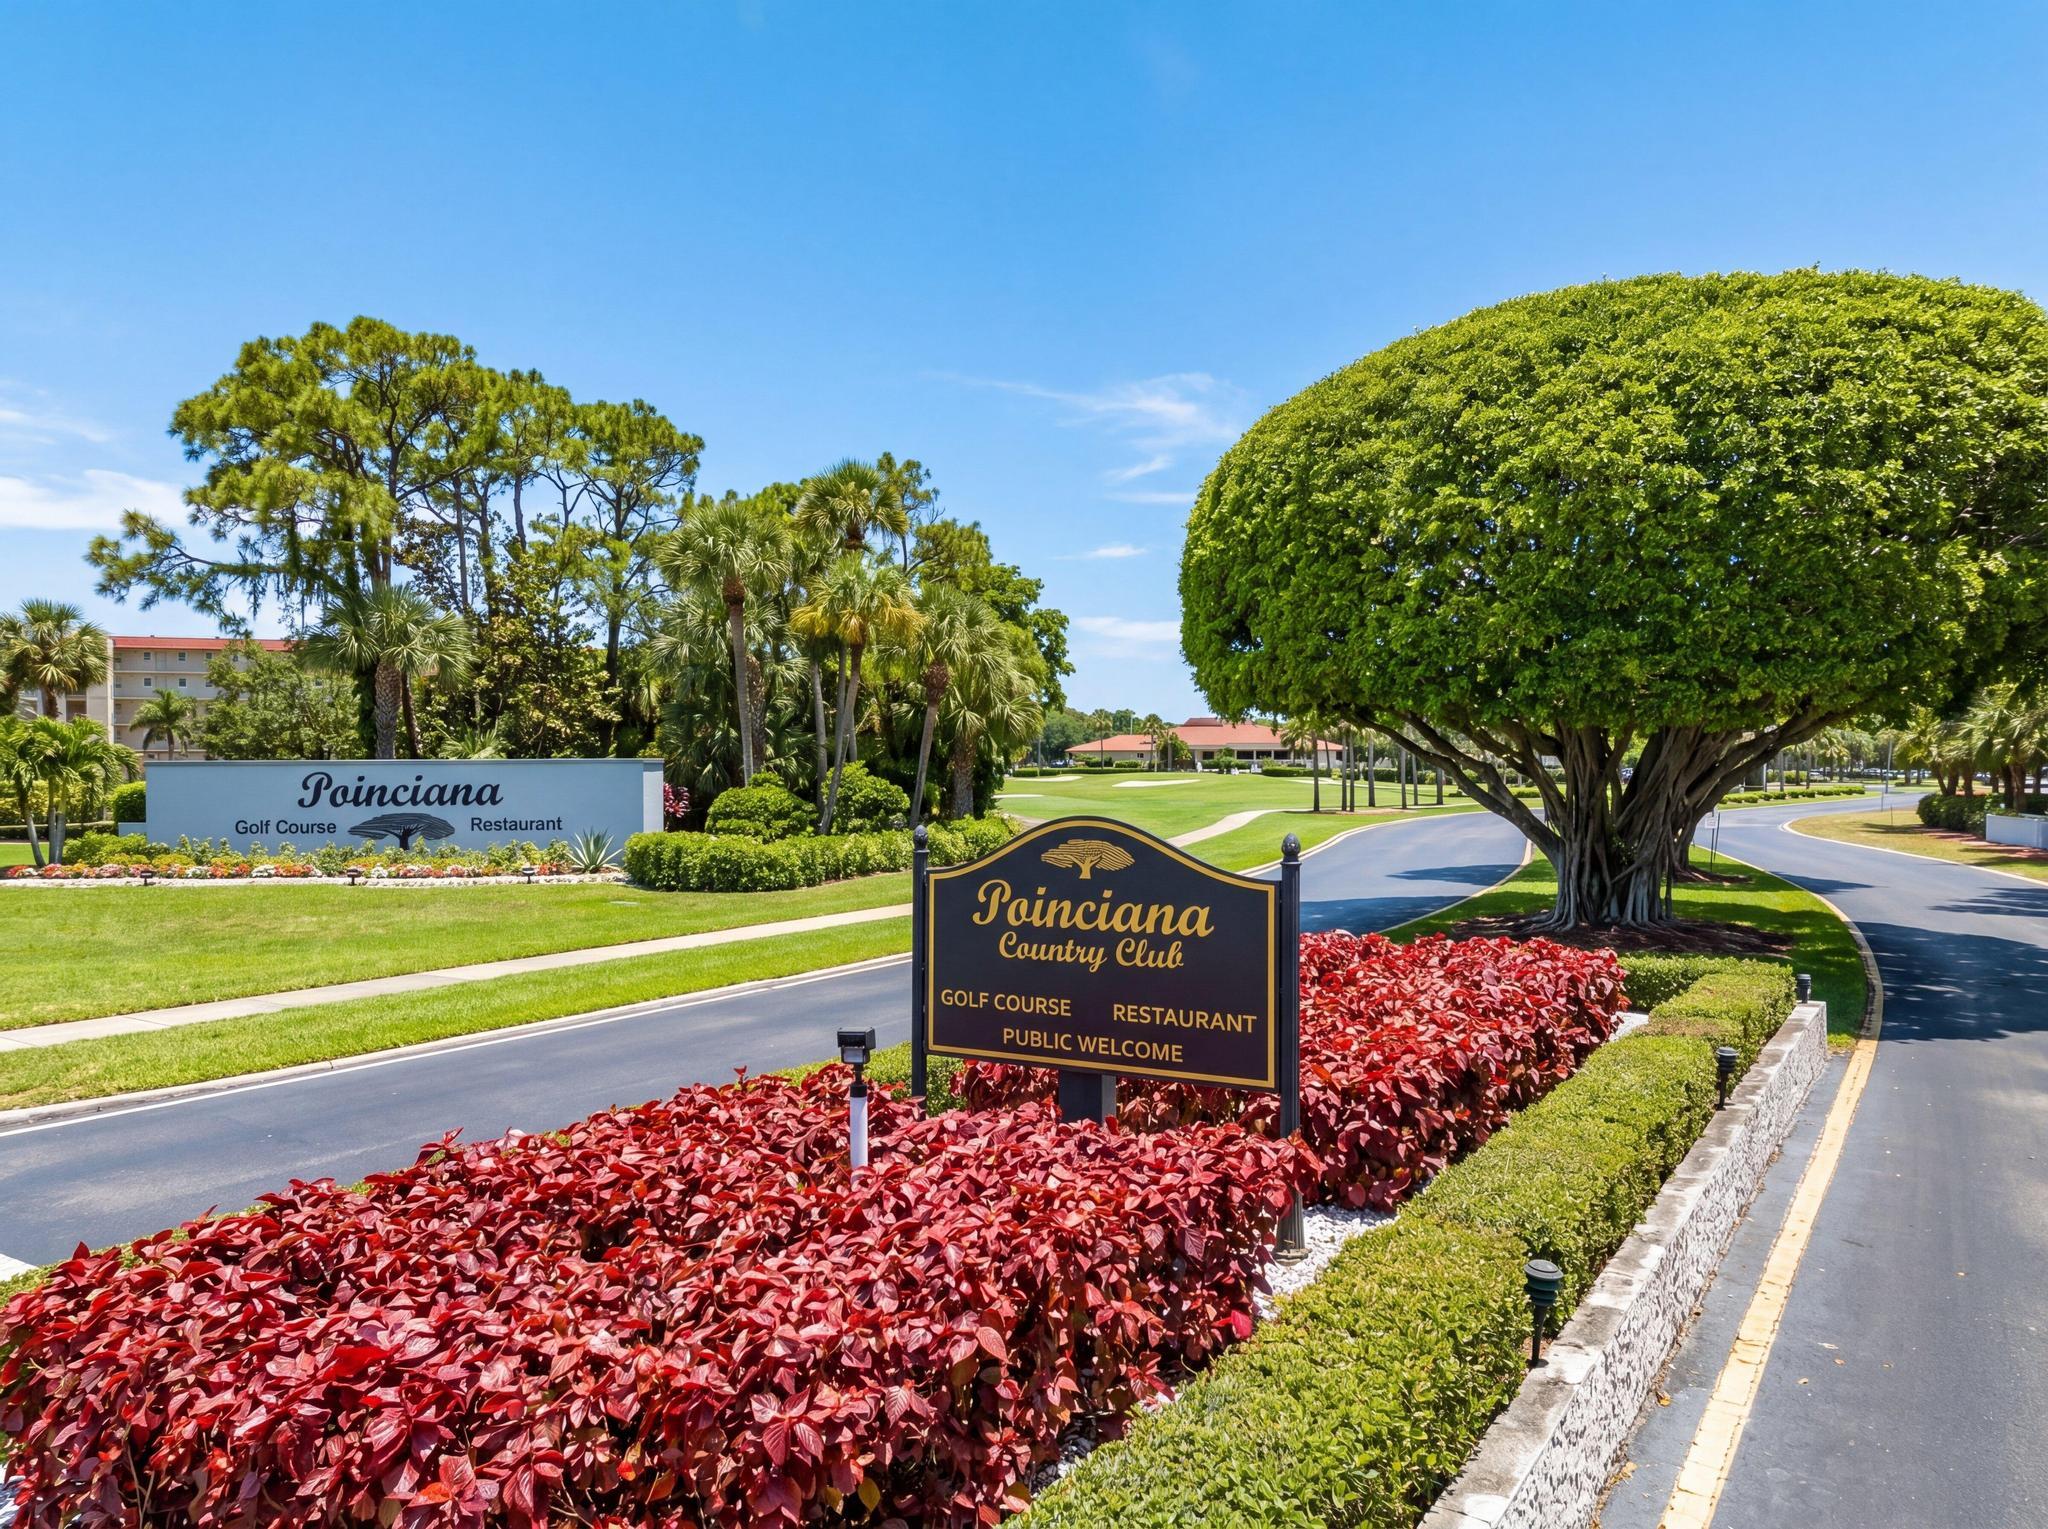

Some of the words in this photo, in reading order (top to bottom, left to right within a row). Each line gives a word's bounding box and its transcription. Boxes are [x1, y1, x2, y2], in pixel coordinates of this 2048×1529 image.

[297, 771, 504, 809] Poinciana
[234, 819, 271, 835] Golf
[275, 819, 337, 835] Course
[470, 815, 563, 832] Restaurant
[972, 879, 1215, 938] Poinciana
[998, 931, 1107, 973] Country
[1115, 937, 1184, 969] Club
[940, 988, 990, 1009] GOLF
[994, 993, 1072, 1017] COURSE
[1113, 1003, 1258, 1033] RESTAURANT
[1002, 1028, 1072, 1052] PUBLIC
[1077, 1034, 1184, 1063] WELCOME
